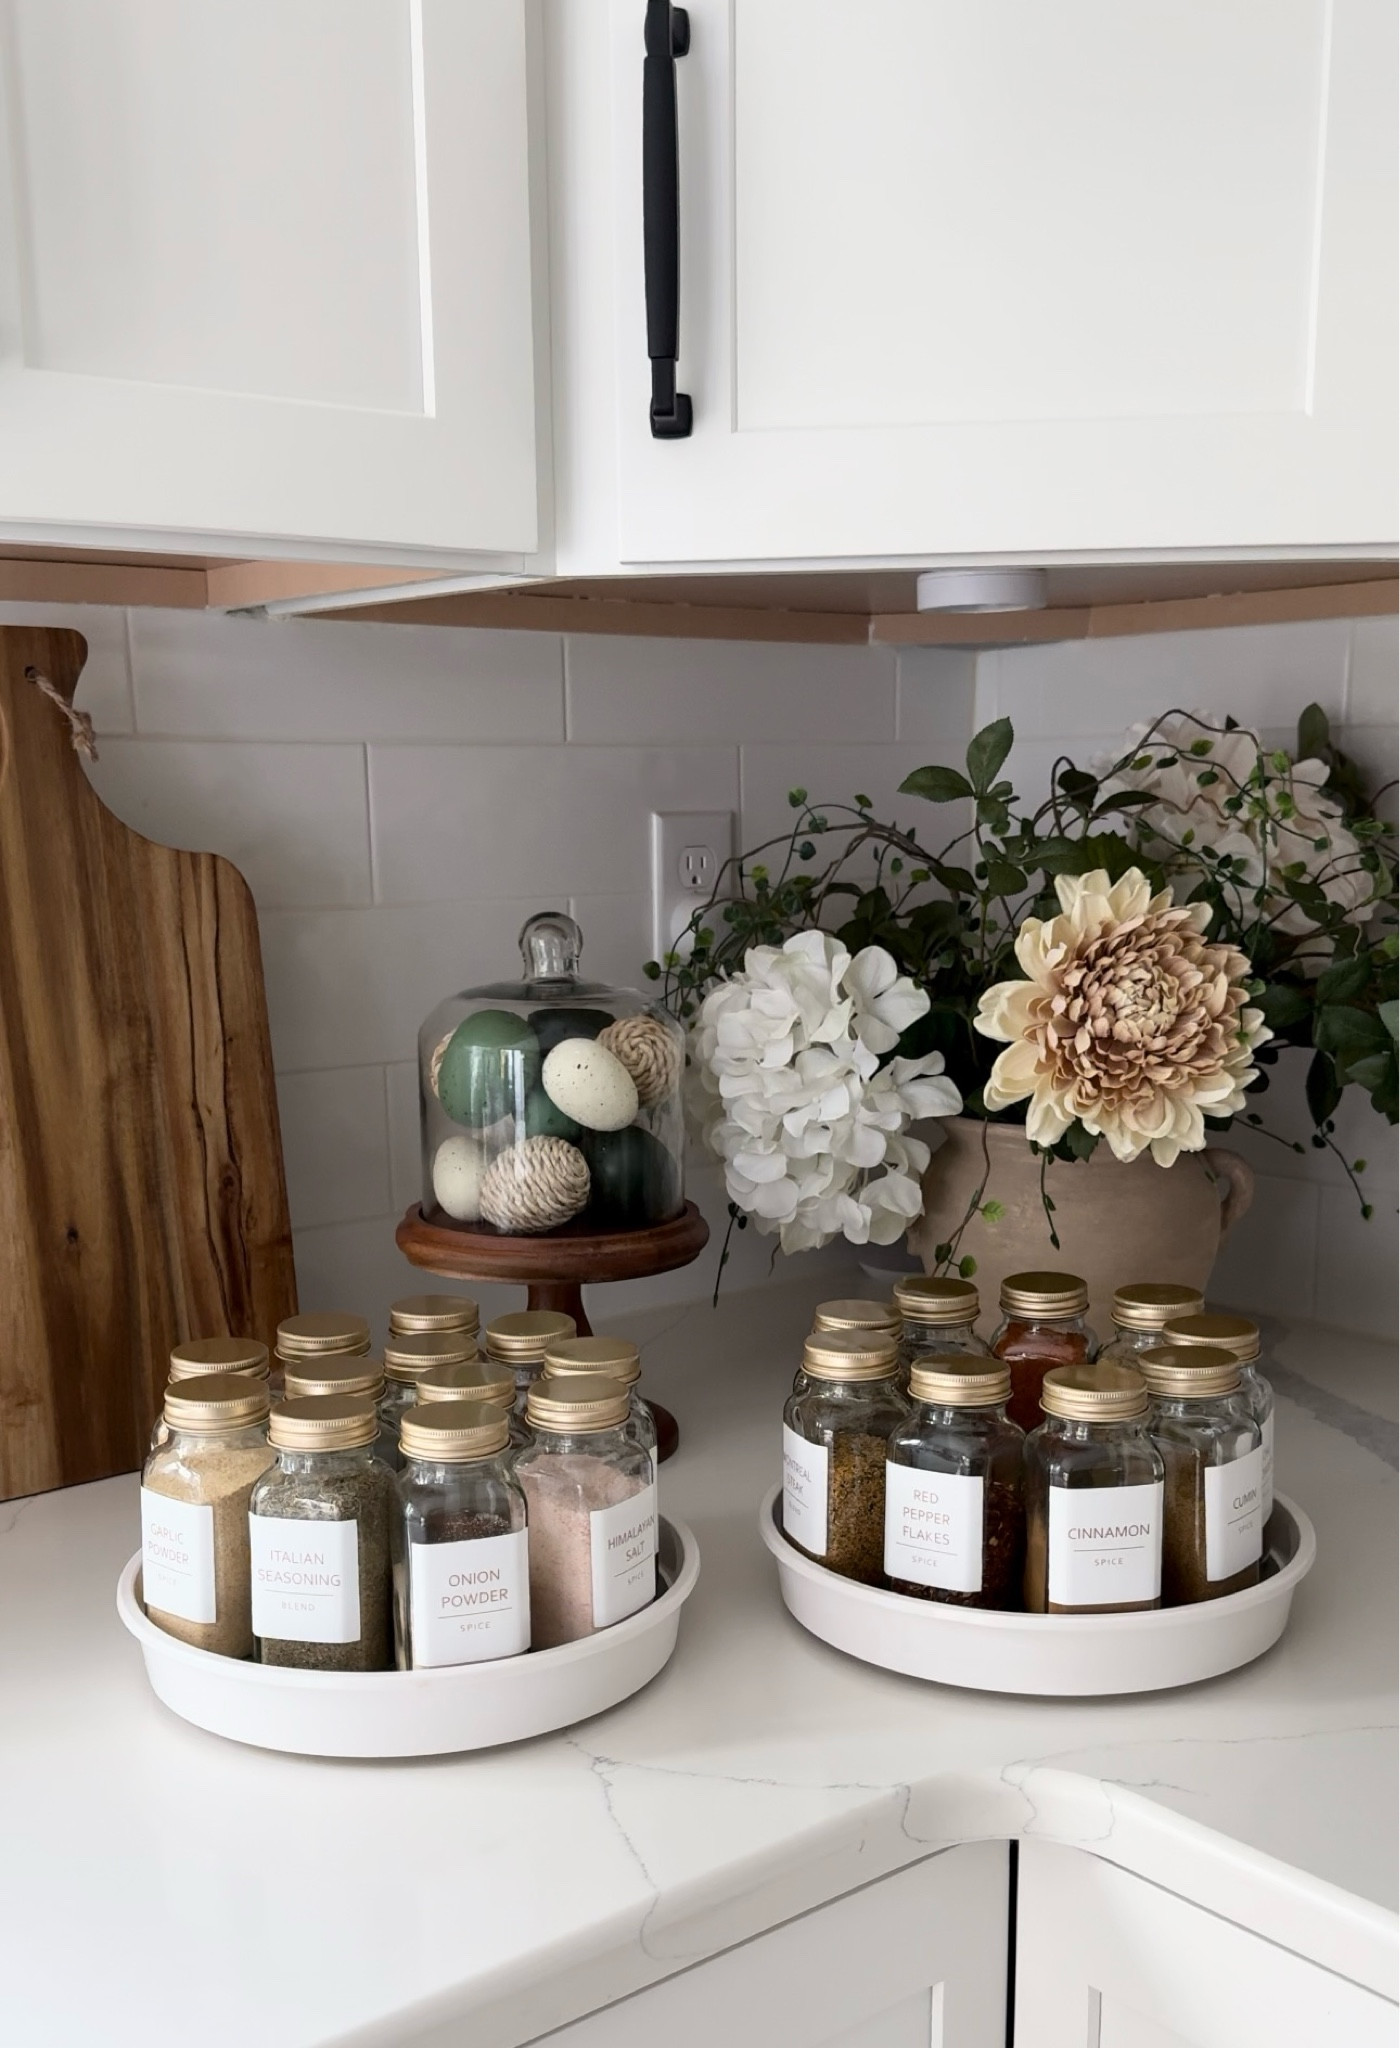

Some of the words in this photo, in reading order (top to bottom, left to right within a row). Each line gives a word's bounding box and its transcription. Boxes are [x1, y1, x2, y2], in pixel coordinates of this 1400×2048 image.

[913, 1489, 939, 1505] RED
[1232, 1487, 1257, 1510] CUMIN
[903, 1506, 950, 1526] PEPPER
[150, 1523, 185, 1545] GARLIC
[608, 1514, 656, 1550] HIMALAYAN
[903, 1525, 950, 1546] FLAKES
[1067, 1523, 1151, 1541] CINNAMON
[148, 1540, 189, 1564] POWDER
[270, 1550, 324, 1565] ITALIAN
[626, 1541, 646, 1562] SALT
[911, 1555, 938, 1568] SPICE
[1094, 1557, 1124, 1567] SPICE
[257, 1569, 341, 1587] SEASONING
[448, 1568, 500, 1588] ONION
[441, 1578, 509, 1609] POWDER
[281, 1600, 316, 1612] BLEND
[460, 1621, 492, 1633] SPICE
